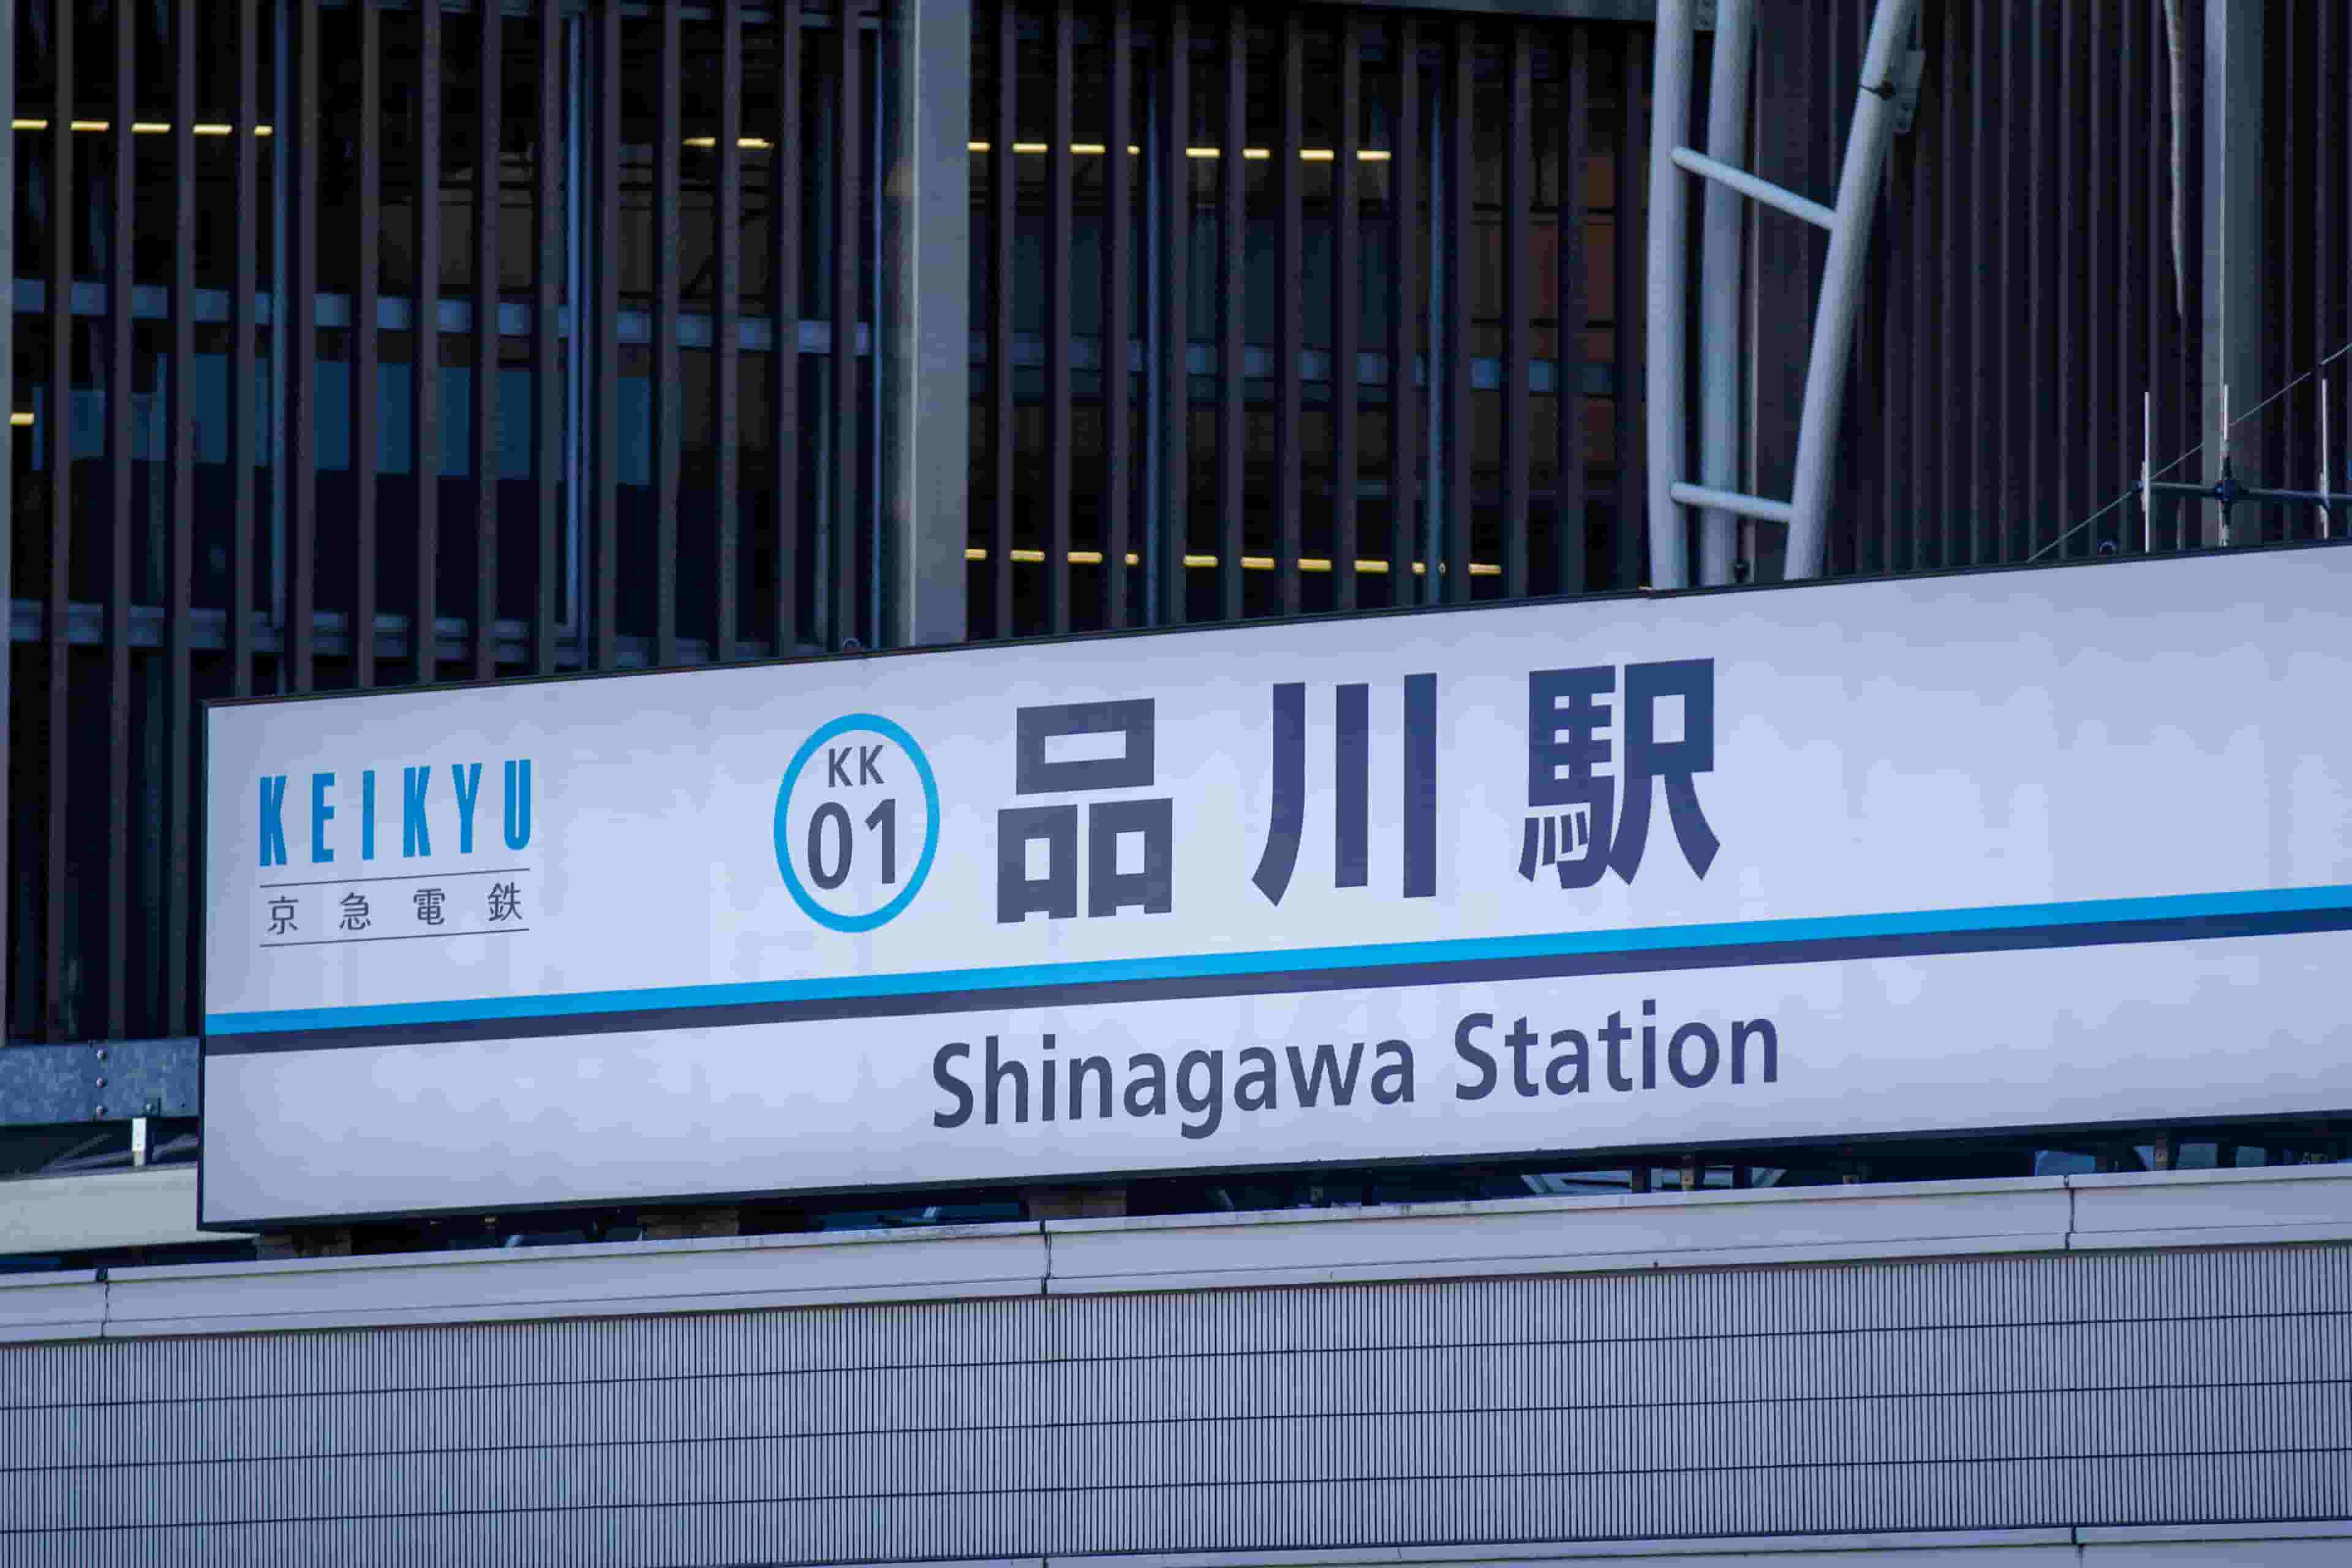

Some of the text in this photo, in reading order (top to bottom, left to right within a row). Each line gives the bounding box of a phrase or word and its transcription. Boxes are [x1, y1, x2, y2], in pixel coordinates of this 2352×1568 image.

[259, 759, 531, 867] KEIKYU
[828, 744, 884, 788] KK
[997, 657, 1721, 924] 品川駅
[807, 798, 895, 890] 01
[267, 881, 523, 936] 京急電鉄
[933, 999, 1778, 1140] Shinagawa Station
